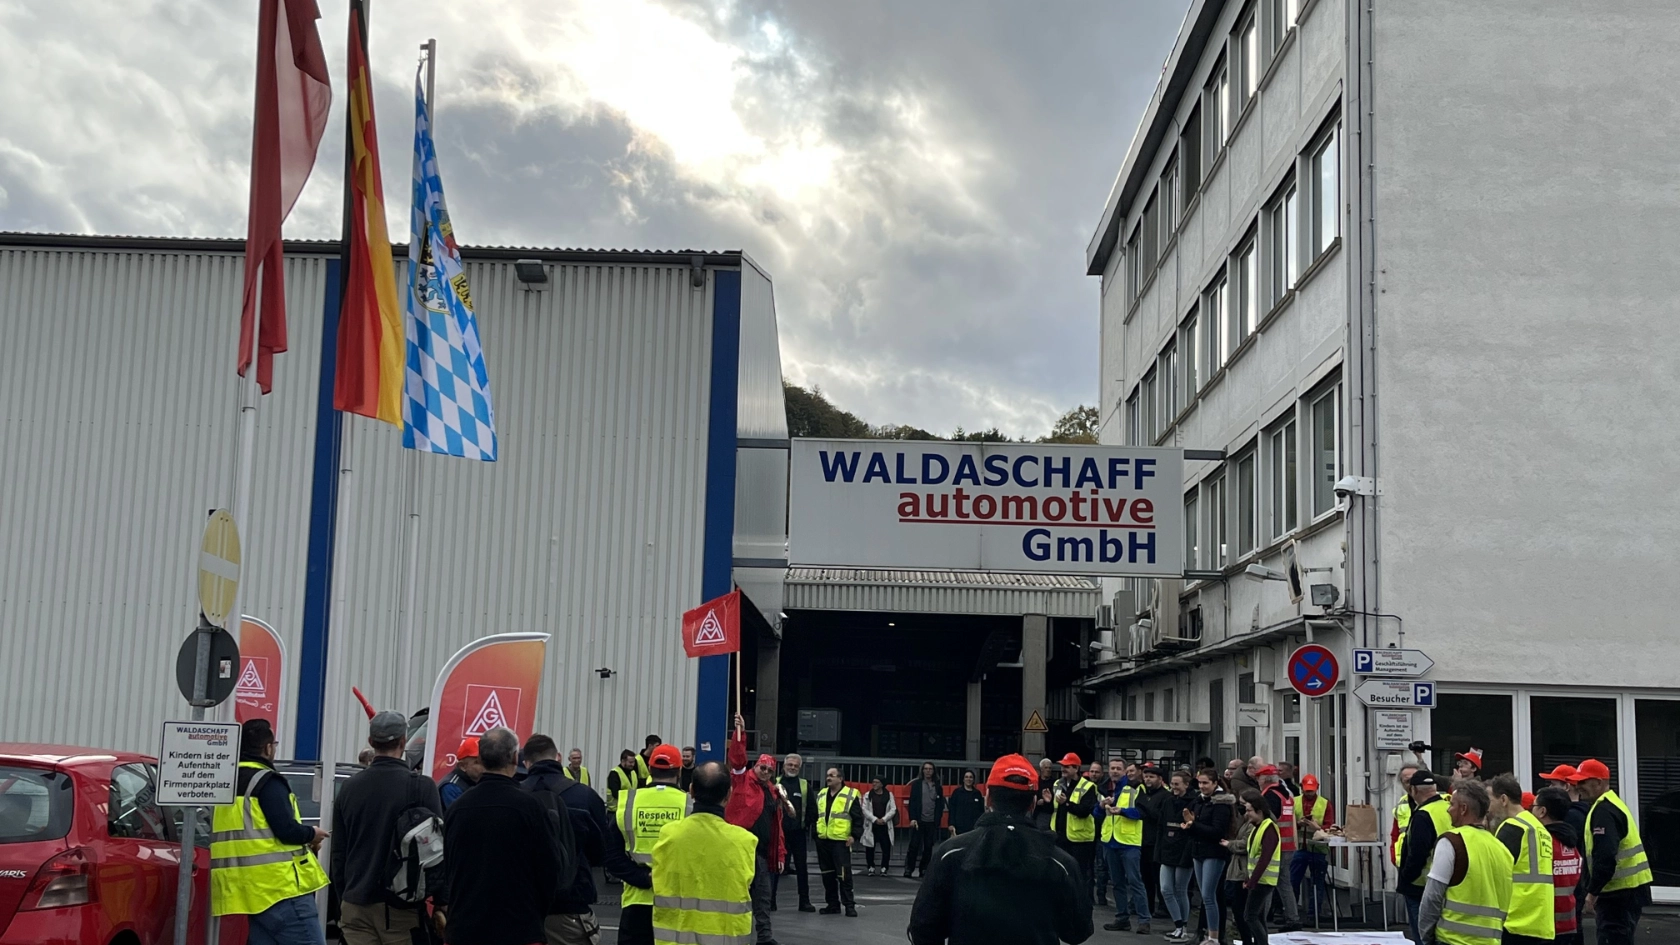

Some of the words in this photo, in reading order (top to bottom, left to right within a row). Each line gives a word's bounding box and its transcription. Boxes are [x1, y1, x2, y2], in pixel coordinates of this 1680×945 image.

[819, 451, 1156, 490] WALDASCHAFF
[897, 488, 1154, 523] automotive
[1022, 528, 1156, 564] GmbH
[1370, 694, 1410, 703] Besucher
[164, 780, 230, 789] Firmenparkplatz
[639, 811, 678, 820] Respekt!
